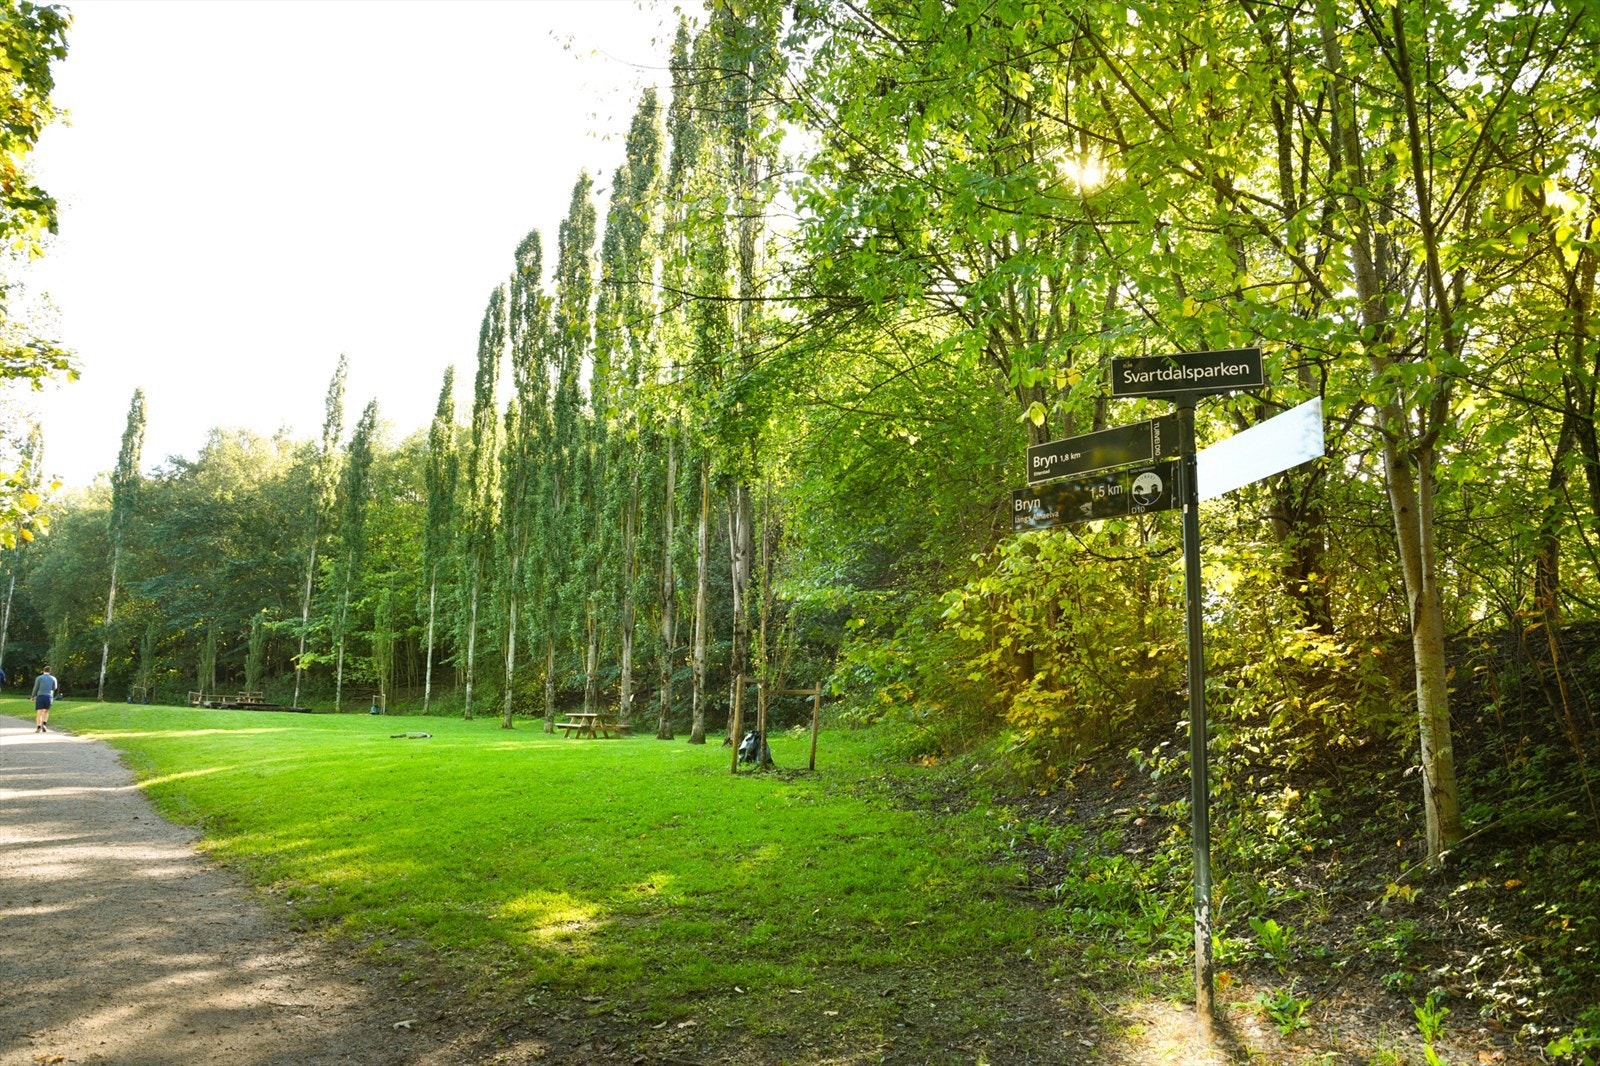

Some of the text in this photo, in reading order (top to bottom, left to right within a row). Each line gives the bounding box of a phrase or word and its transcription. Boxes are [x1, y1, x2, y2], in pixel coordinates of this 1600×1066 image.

[1123, 362, 1250, 384] Svartdalsparken
[1033, 452, 1081, 468] Bryn 1,8 km
[1090, 484, 1123, 500] 1,5 km
[1015, 498, 1040, 512] Bryn
[1131, 506, 1146, 514] D10
